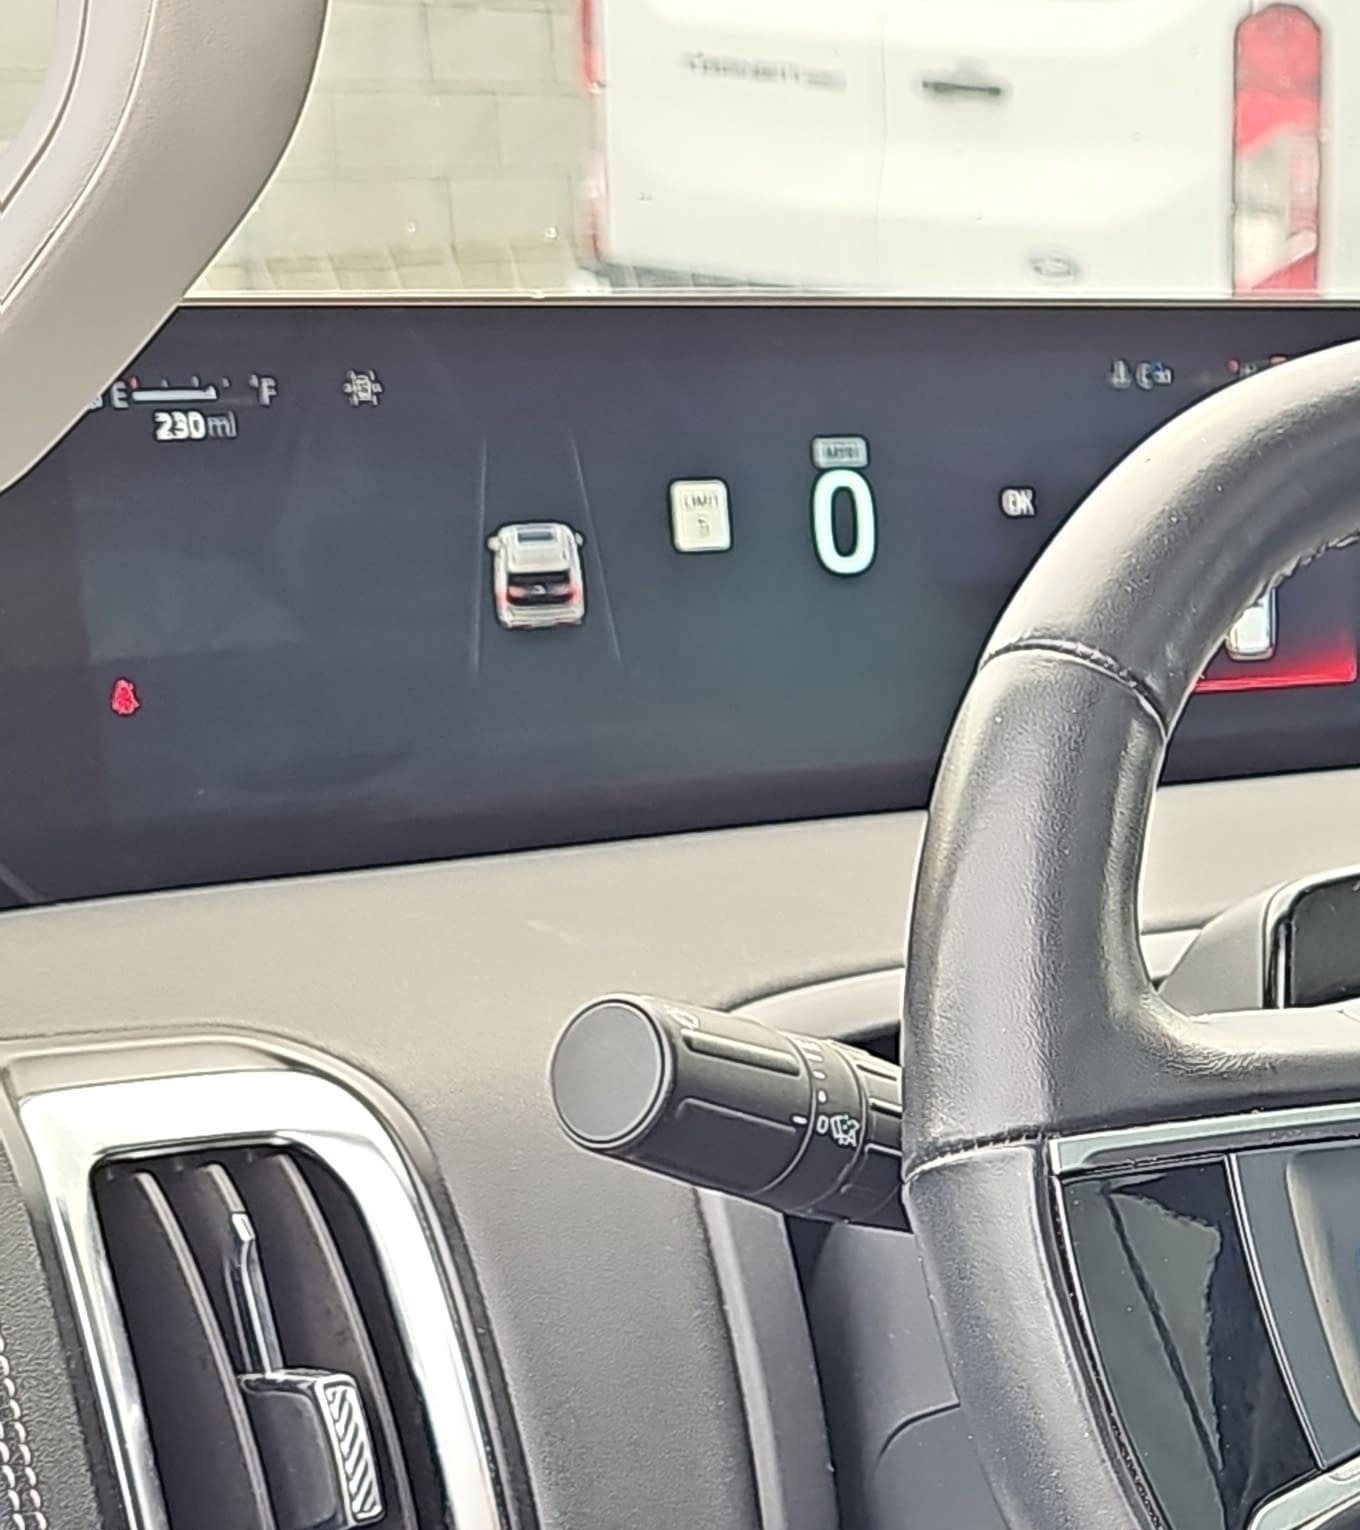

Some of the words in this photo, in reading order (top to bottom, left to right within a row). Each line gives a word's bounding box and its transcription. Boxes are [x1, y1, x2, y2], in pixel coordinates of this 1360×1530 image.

[112, 381, 129, 409] E
[260, 377, 277, 406] F
[813, 468, 876, 574] 0
